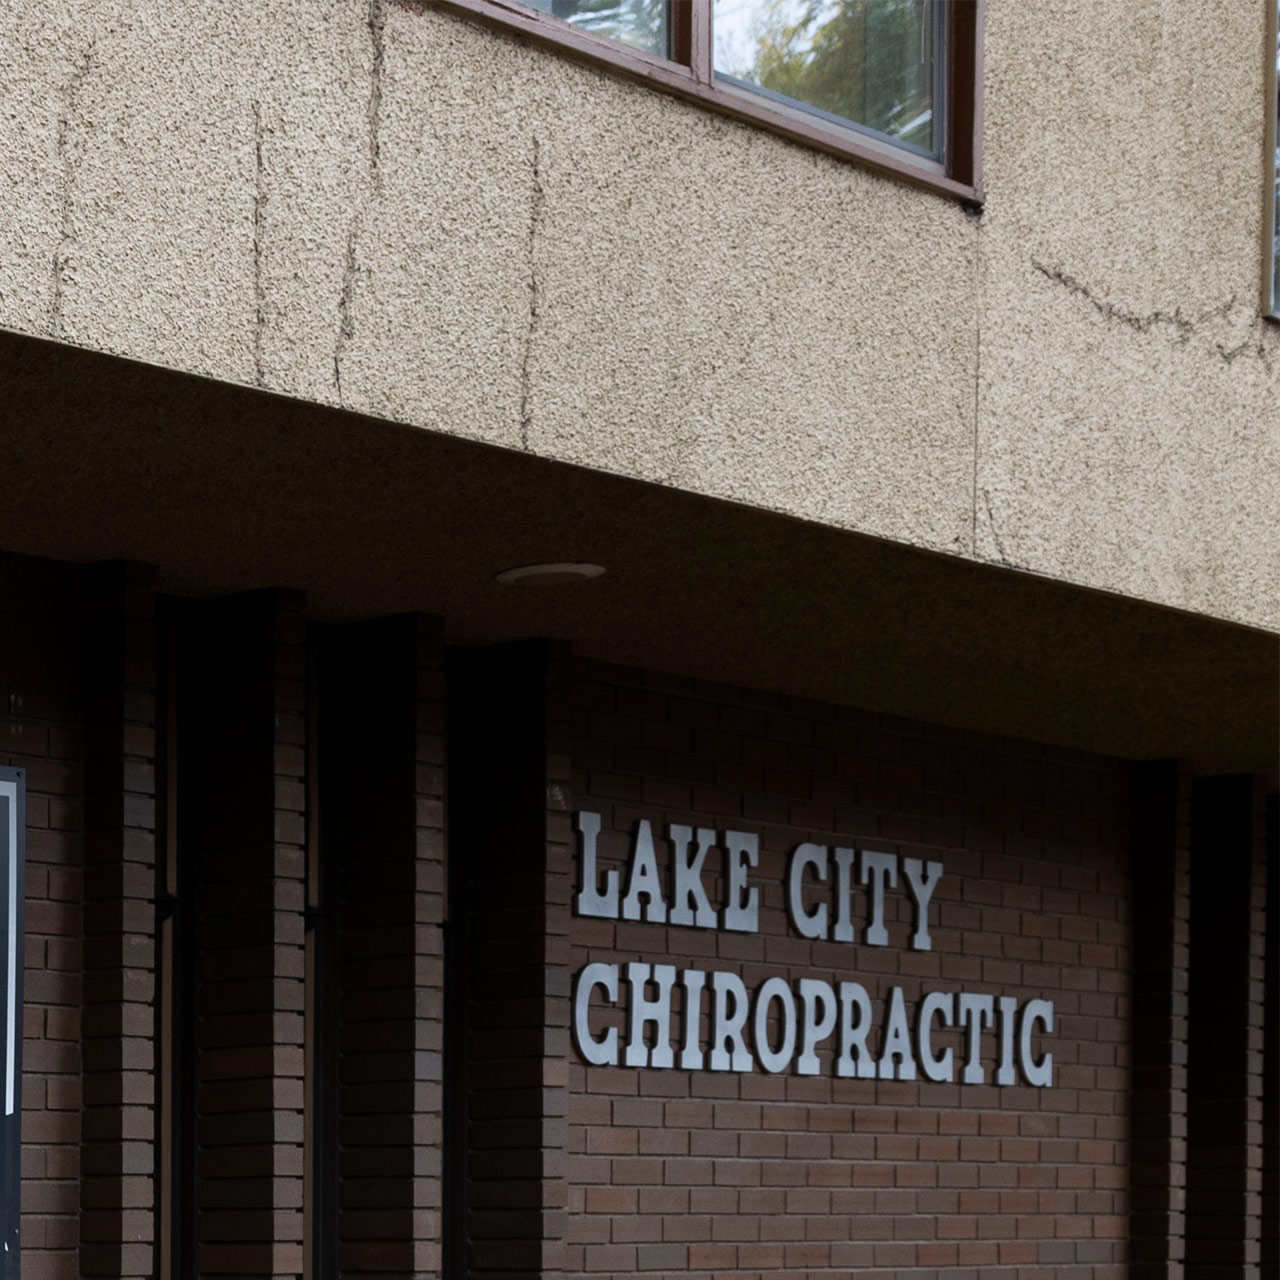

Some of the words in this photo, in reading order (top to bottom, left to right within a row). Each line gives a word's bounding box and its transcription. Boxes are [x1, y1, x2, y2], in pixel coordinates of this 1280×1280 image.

[573, 811, 760, 933] LAKE
[786, 843, 943, 951] CITY
[572, 961, 1054, 1088] CHIROPRACTIC
